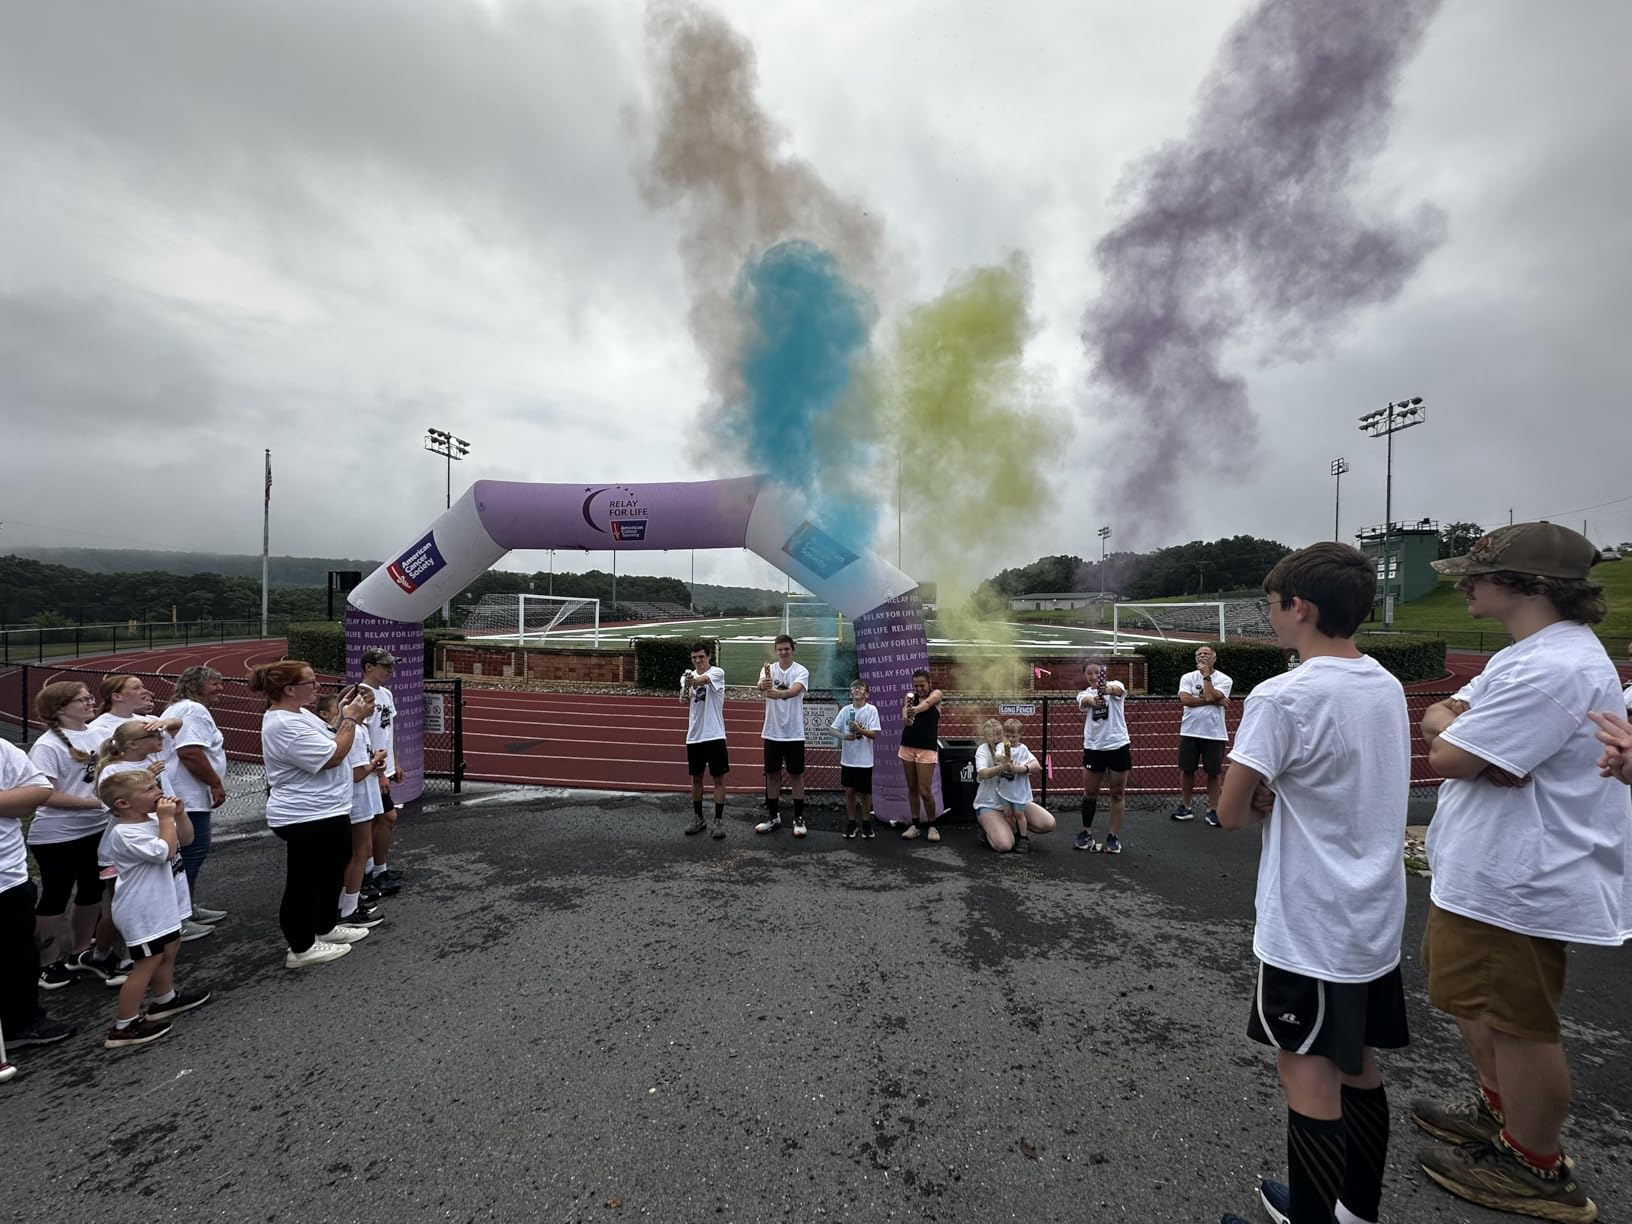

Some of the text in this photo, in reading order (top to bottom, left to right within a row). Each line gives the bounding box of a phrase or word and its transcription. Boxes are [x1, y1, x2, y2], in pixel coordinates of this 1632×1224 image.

[402, 542, 432, 568] American
[404, 553, 428, 573] Cancer
[409, 558, 434, 579] Society
[892, 624, 913, 632] RELAY
[868, 641, 889, 649] RELAY
[878, 655, 893, 663] LIFE
[896, 653, 917, 661] RELAY
[872, 670, 894, 678] RELAY
